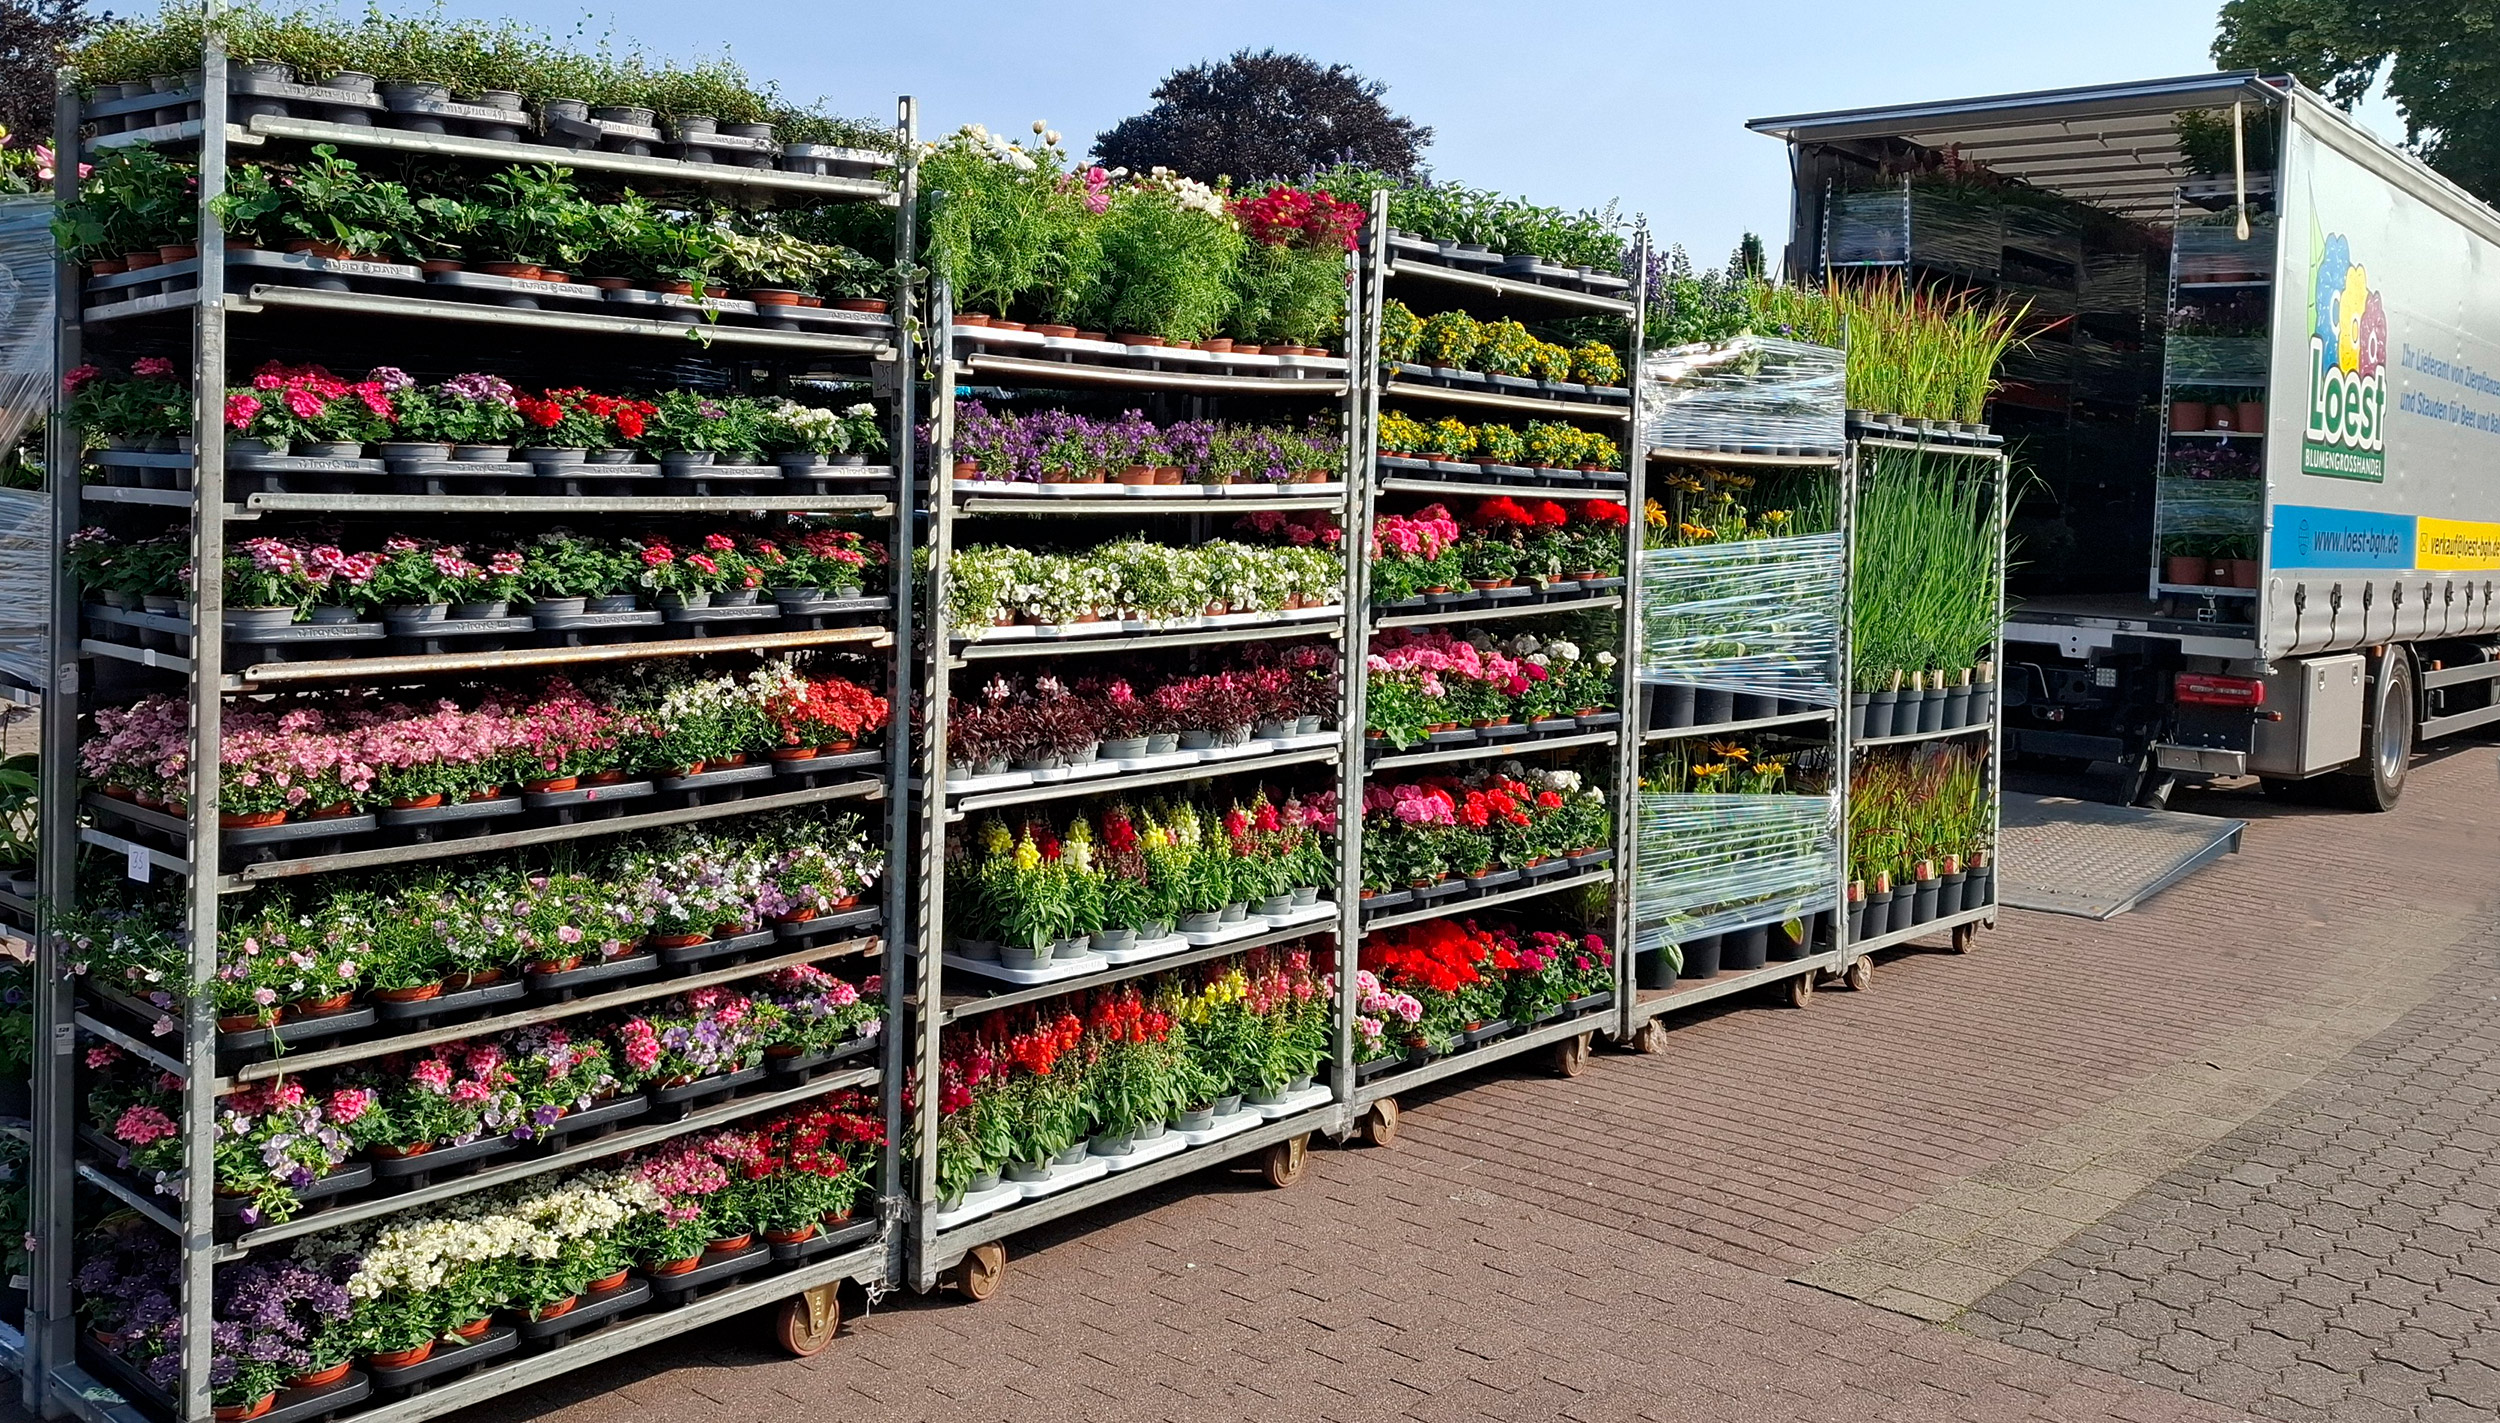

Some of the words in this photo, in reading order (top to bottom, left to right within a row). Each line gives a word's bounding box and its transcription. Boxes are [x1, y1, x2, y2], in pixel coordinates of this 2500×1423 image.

[2402, 343, 2415, 369] Ihr
[2416, 348, 2449, 381] Lieferant
[2451, 366, 2464, 385] von
[2308, 342, 2386, 447] Loest
[2400, 389, 2416, 413] und
[2417, 392, 2447, 421] Stauden
[2449, 401, 2460, 423] für
[2461, 404, 2476, 429] Beet
[2477, 411, 2489, 432] und
[2304, 448, 2382, 477] BLUMENGROSSHANDEL
[2314, 526, 2399, 560] www.loest-bgh.de
[2430, 532, 2500, 562] verkauf@loest-bgh.de
